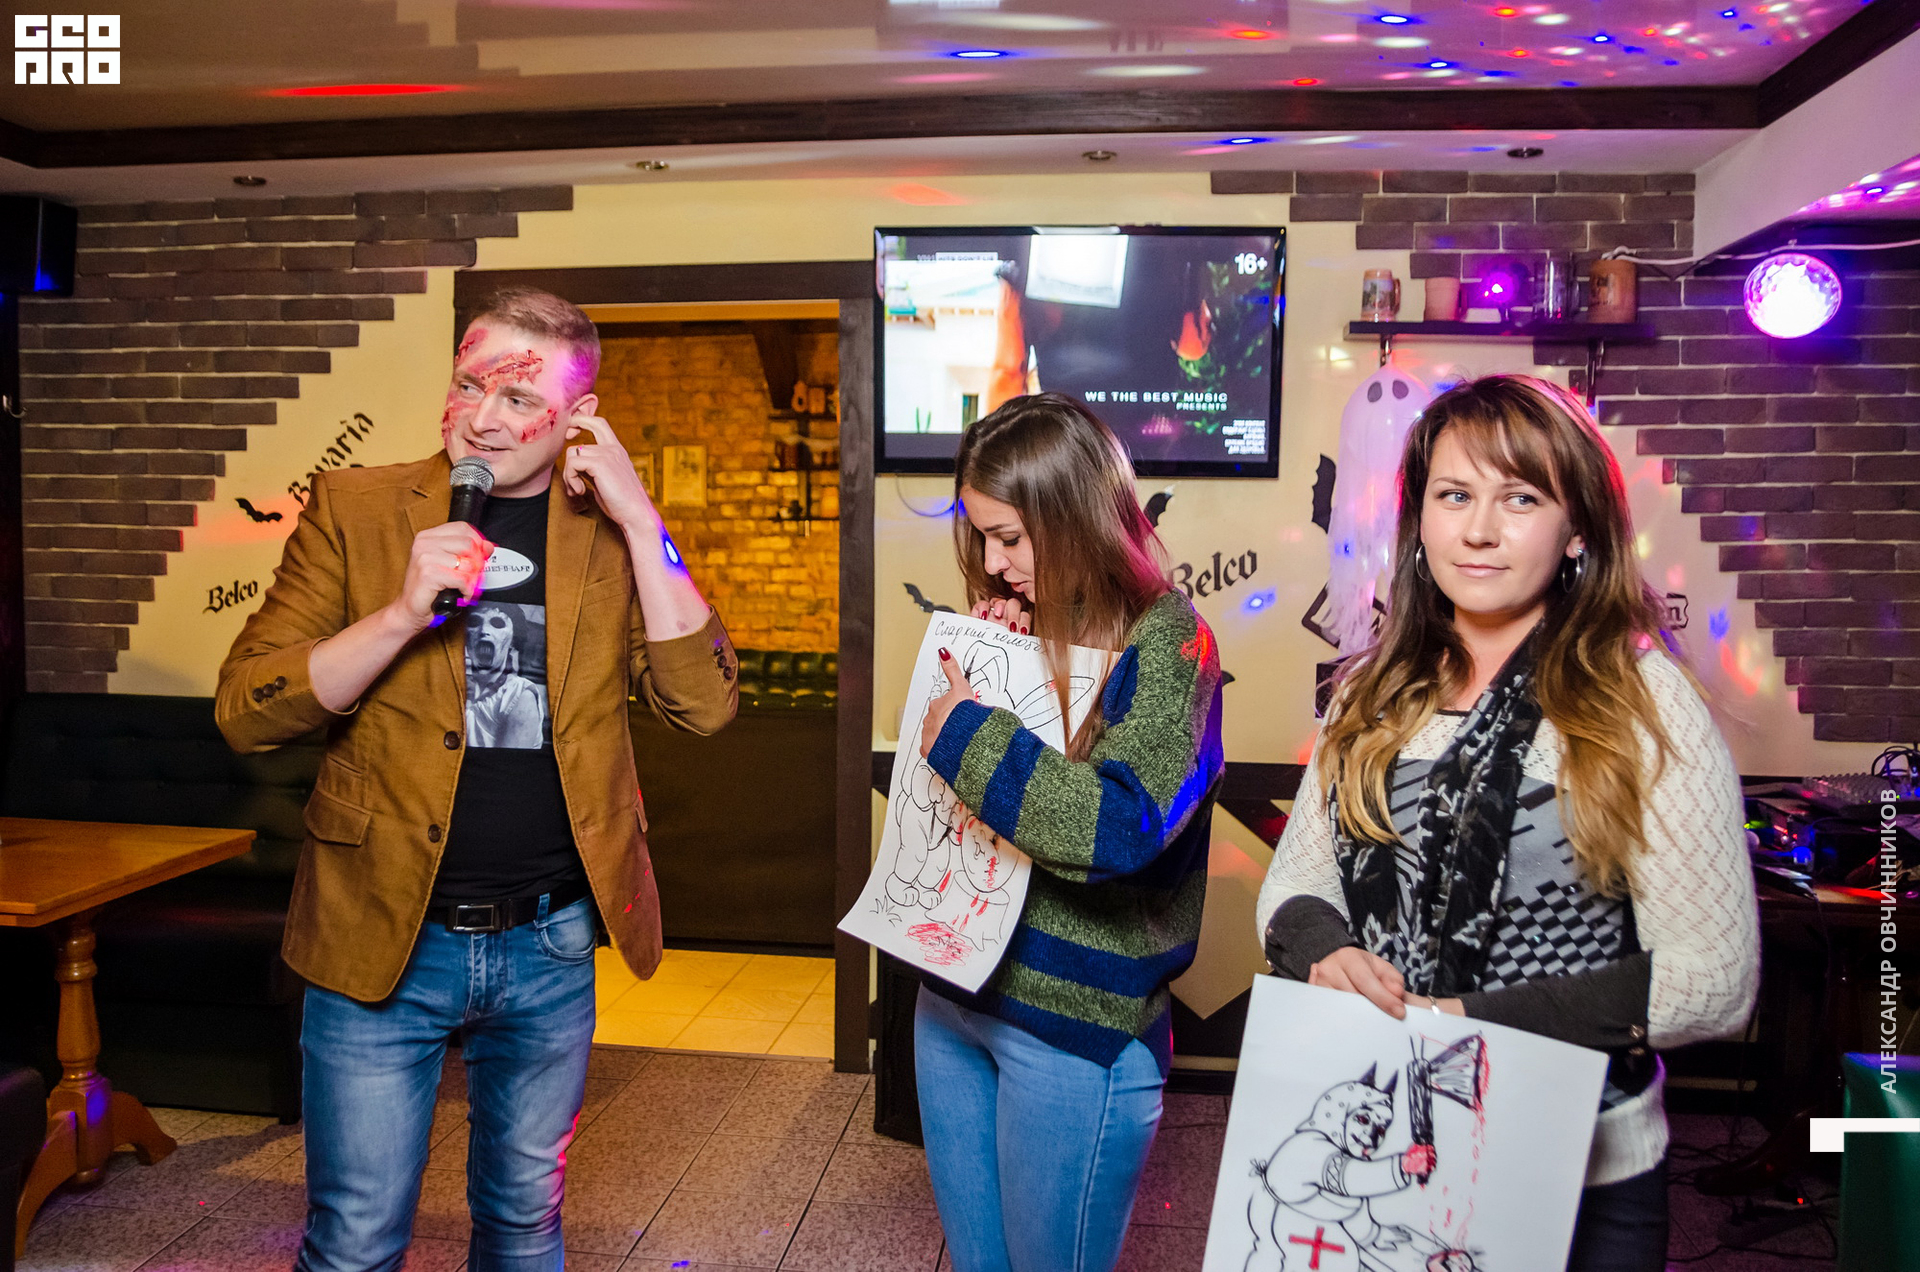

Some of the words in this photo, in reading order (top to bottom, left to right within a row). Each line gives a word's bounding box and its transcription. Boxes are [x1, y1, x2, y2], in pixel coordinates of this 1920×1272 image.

[1234, 252, 1268, 275] 16+
[1085, 391, 1106, 402] WE
[1111, 391, 1138, 402] THE
[1143, 392, 1178, 402] BEST
[1184, 392, 1228, 402] MUSIC
[1176, 402, 1228, 411] PRESENTS
[1172, 549, 1258, 600] Belco
[203, 579, 258, 614] Belco
[934, 620, 988, 645] Сладкий
[992, 632, 1047, 656] колобо
